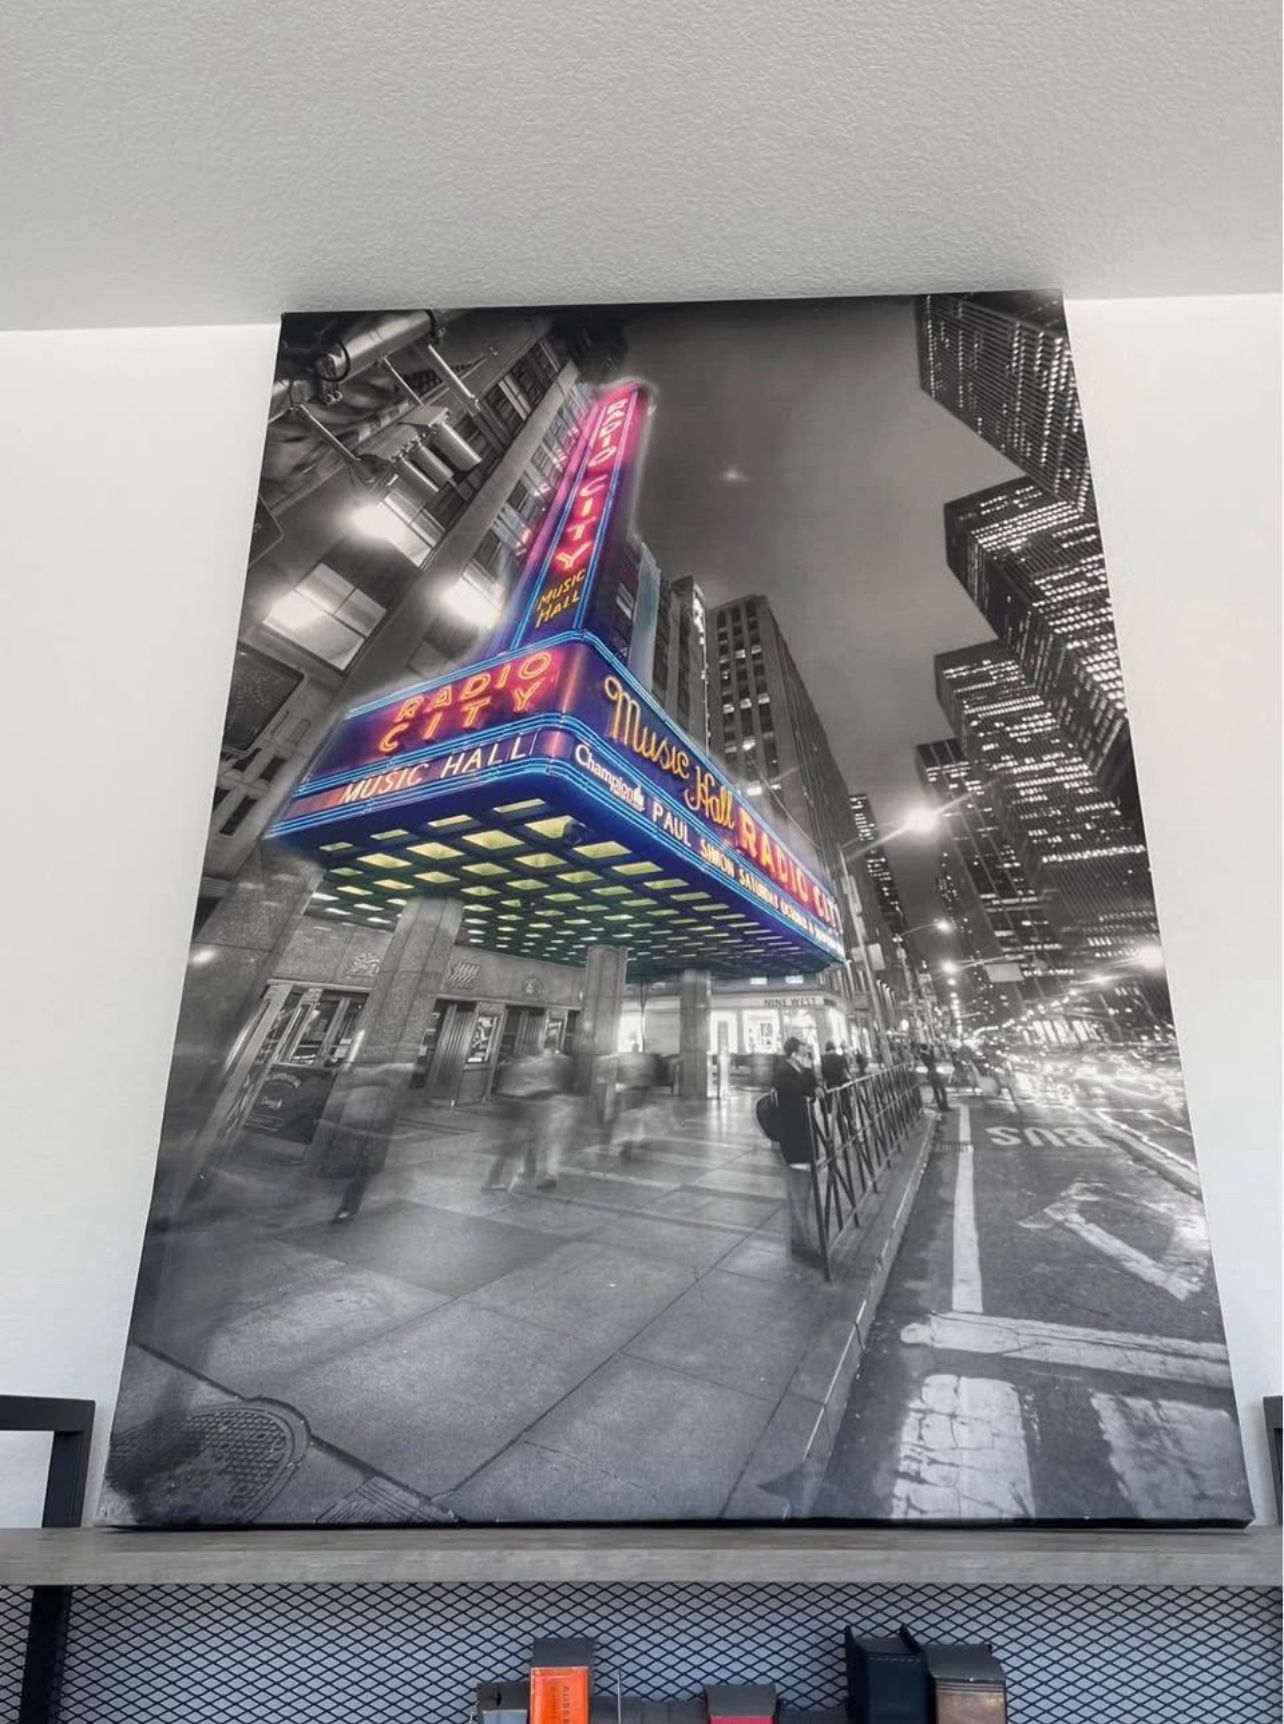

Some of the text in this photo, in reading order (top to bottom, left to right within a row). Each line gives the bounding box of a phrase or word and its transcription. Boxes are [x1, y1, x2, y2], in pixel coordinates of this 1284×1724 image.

[555, 398, 628, 570] RADIO CITY
[535, 591, 580, 628] HALL
[538, 568, 587, 611] MUSIC
[379, 679, 545, 753] CITY
[394, 652, 552, 723] RADIO
[339, 736, 528, 804] MUSIC HALL
[603, 674, 690, 780] Music
[684, 766, 735, 830] Hall
[739, 805, 809, 903] RADIO
[652, 800, 692, 848] PAUL
